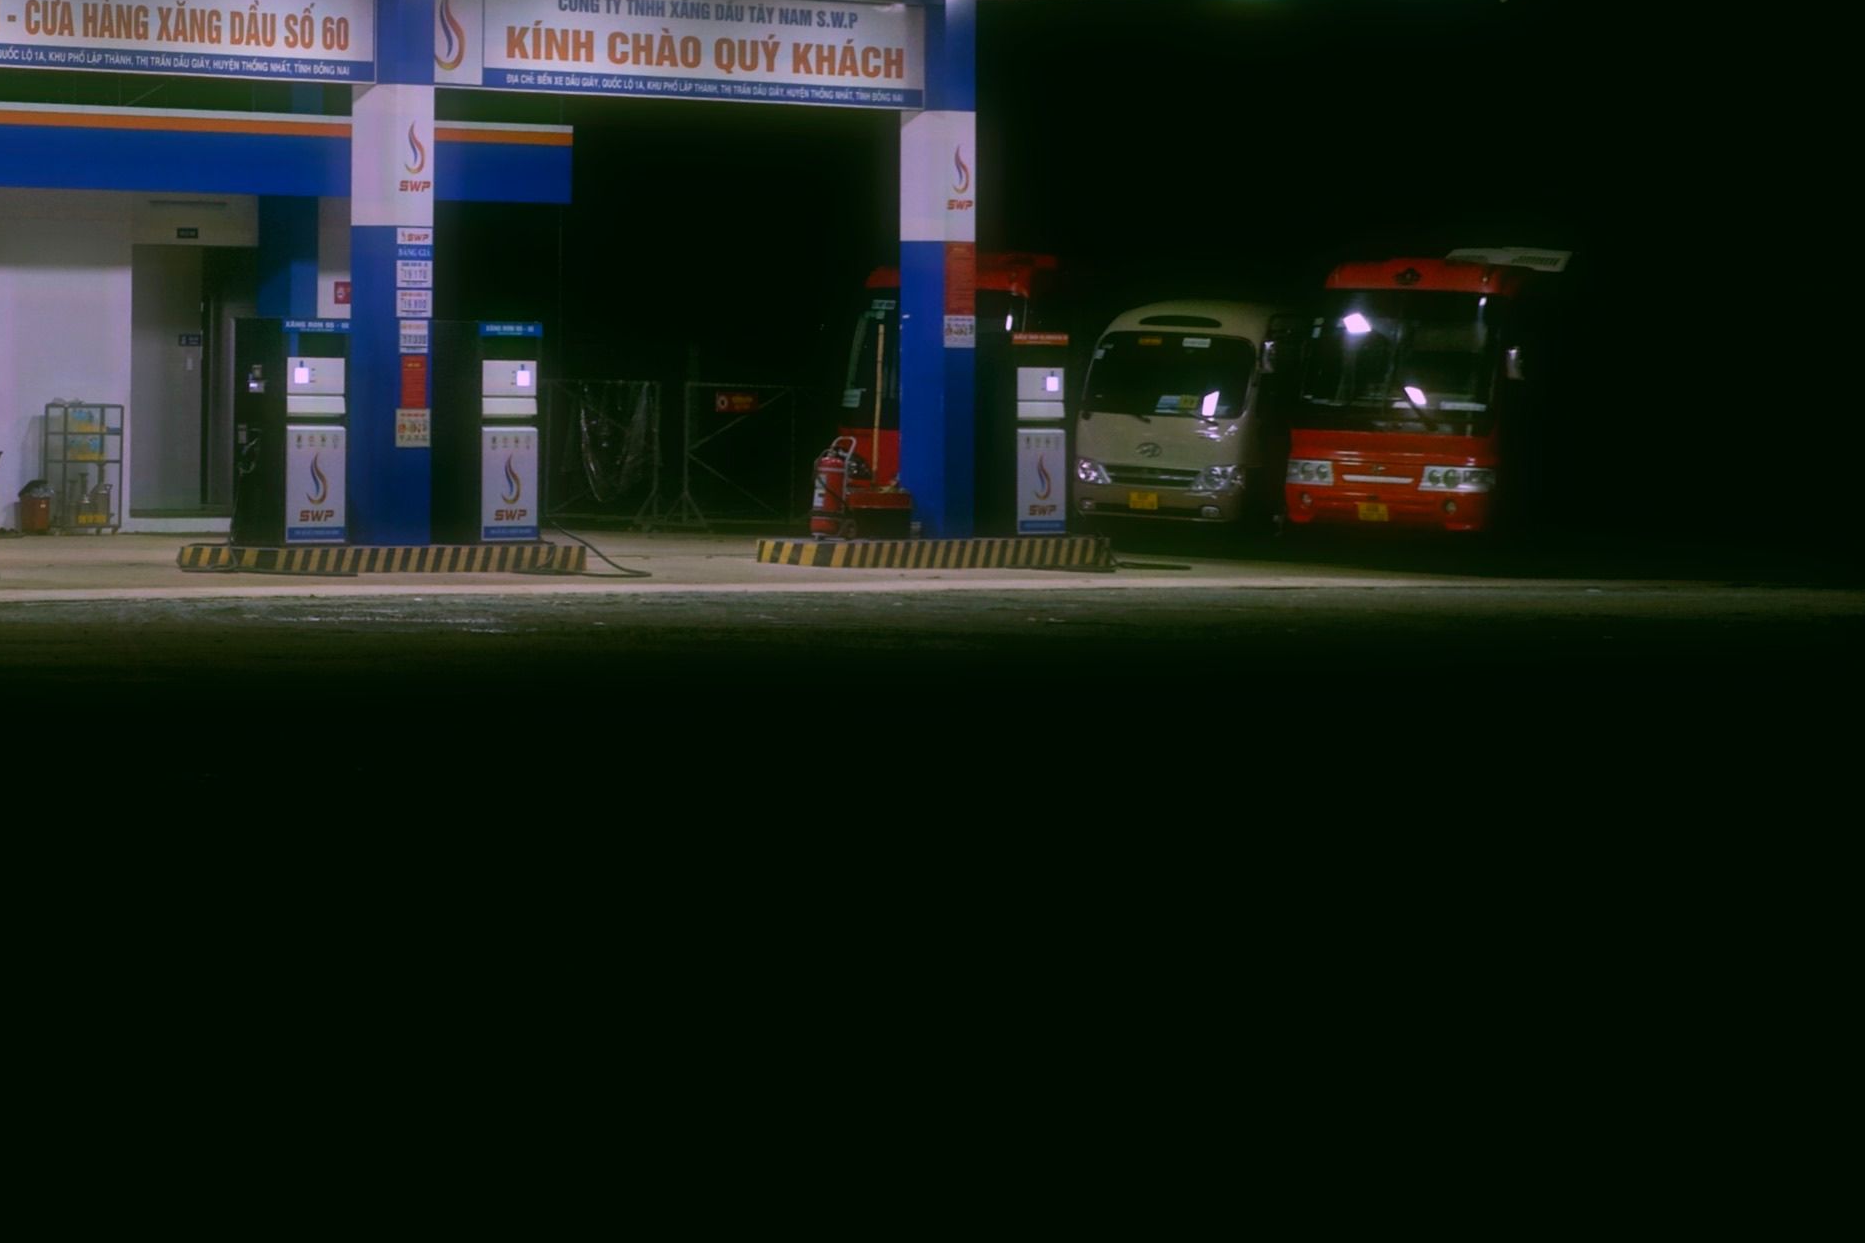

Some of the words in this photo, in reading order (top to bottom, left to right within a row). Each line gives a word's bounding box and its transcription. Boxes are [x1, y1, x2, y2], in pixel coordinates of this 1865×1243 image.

[748, 1, 775, 24] TÂY
[779, 8, 812, 26] NAM
[816, 10, 858, 29] S.W.P
[157, 0, 222, 45] XĂNG
[230, 0, 276, 47] DẦU
[284, 2, 315, 50] SỐ
[321, 16, 349, 51] 60
[506, 19, 595, 63] KÍNH
[606, 27, 701, 68] CHÀO
[714, 33, 780, 73] QUÝ
[791, 38, 904, 79] KHÁCH
[48, 52, 66, 63] KHU
[336, 65, 350, 76] NAI
[554, 76, 564, 86] XE
[647, 81, 662, 90] KHU
[398, 180, 431, 192] SWP
[947, 199, 973, 210] SWP
[299, 510, 335, 522] SWP
[494, 509, 527, 521] SWP
[1029, 504, 1057, 516] SWP
